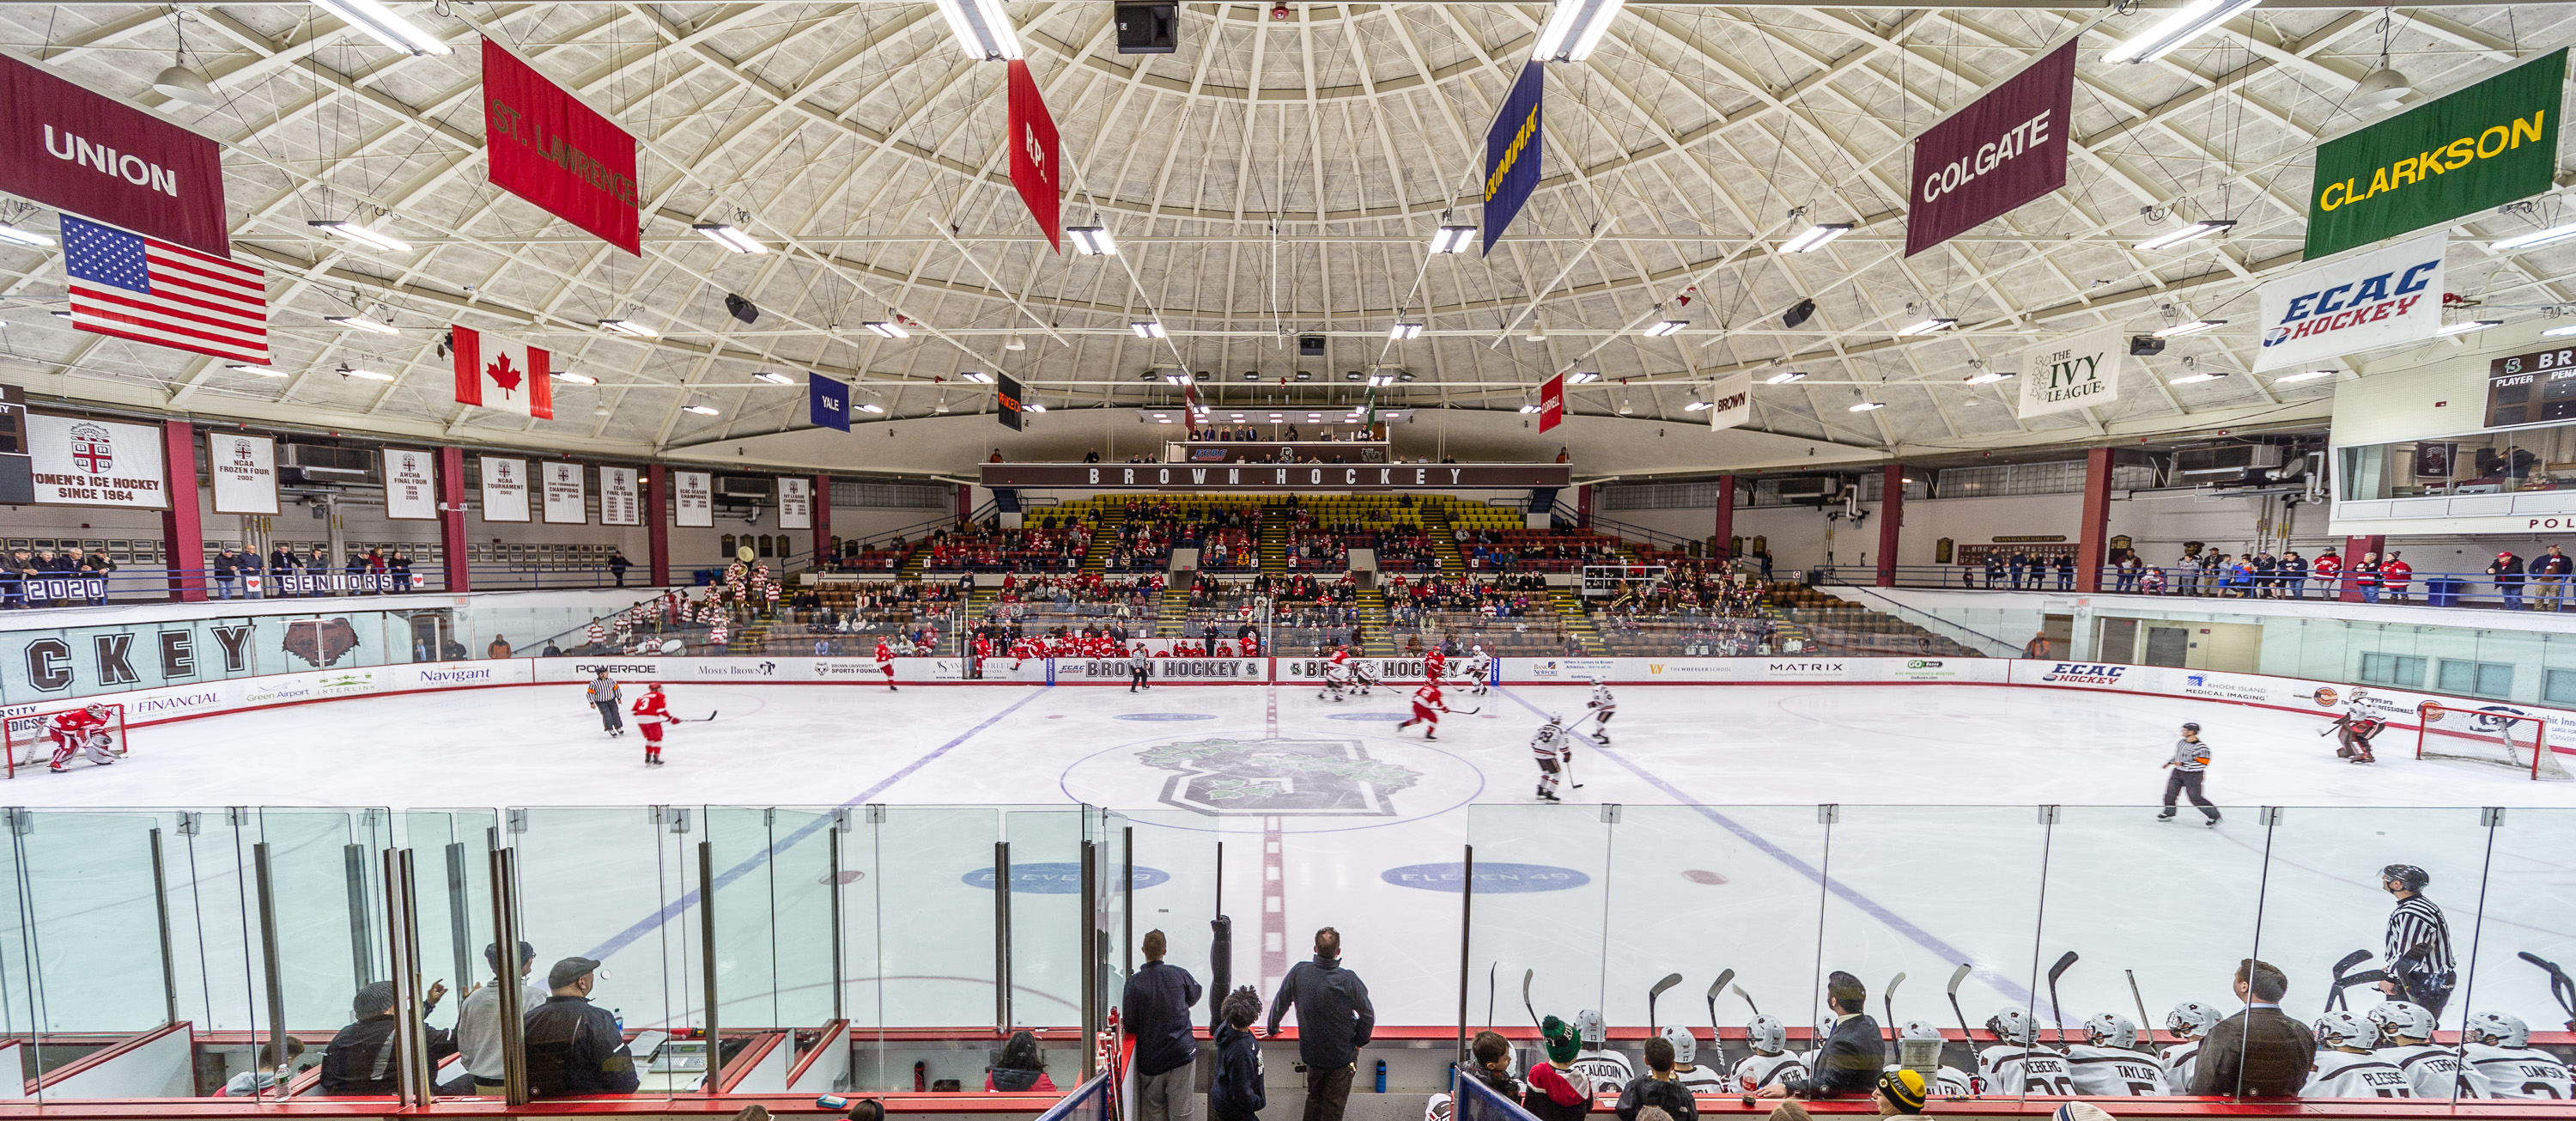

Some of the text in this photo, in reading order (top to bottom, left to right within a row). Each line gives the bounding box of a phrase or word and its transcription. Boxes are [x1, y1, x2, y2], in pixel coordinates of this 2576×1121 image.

[44, 124, 177, 198] UNION
[490, 98, 637, 208] ST. LAWRENCE
[1923, 108, 2050, 203] COLGATE
[2320, 109, 2544, 211] CLARKSON
[2281, 259, 2441, 325] ECAC
[2291, 294, 2421, 340] HOCKEY
[2052, 350, 2071, 361] THE
[2049, 352, 2104, 389] IVY
[2496, 375, 2534, 387] PLAYER
[2047, 381, 2102, 403] LEAGUE
[822, 395, 840, 411] YALE
[1717, 392, 1747, 413] BROWN
[89, 476, 110, 487] ICE
[113, 478, 159, 490] HOCKEY
[1090, 468, 1461, 484] BROWN HOCKEY
[58, 487, 134, 501] SINCE 1964
[29, 579, 104, 599] 2020
[283, 575, 392, 590] SENIORS
[25, 624, 257, 692] CKEY
[1908, 660, 1923, 668] GO
[420, 667, 491, 683] Navigant
[1163, 660, 1242, 678] HOCKEY
[2051, 663, 2126, 678] ECAC
[2058, 674, 2119, 685] HOCKEY
[2208, 682, 2237, 691] RHODE
[246, 687, 309, 702] Green Airport
[318, 685, 376, 695] INTERLINK
[2185, 688, 2265, 701] MEDICAL IMAGING
[139, 693, 221, 713] FINANCIAL
[638, 697, 650, 711] 3
[1530, 872, 1571, 881] 49
[2115, 1064, 2157, 1081] TAYLOR
[2362, 1072, 2407, 1087] PLESSIS
